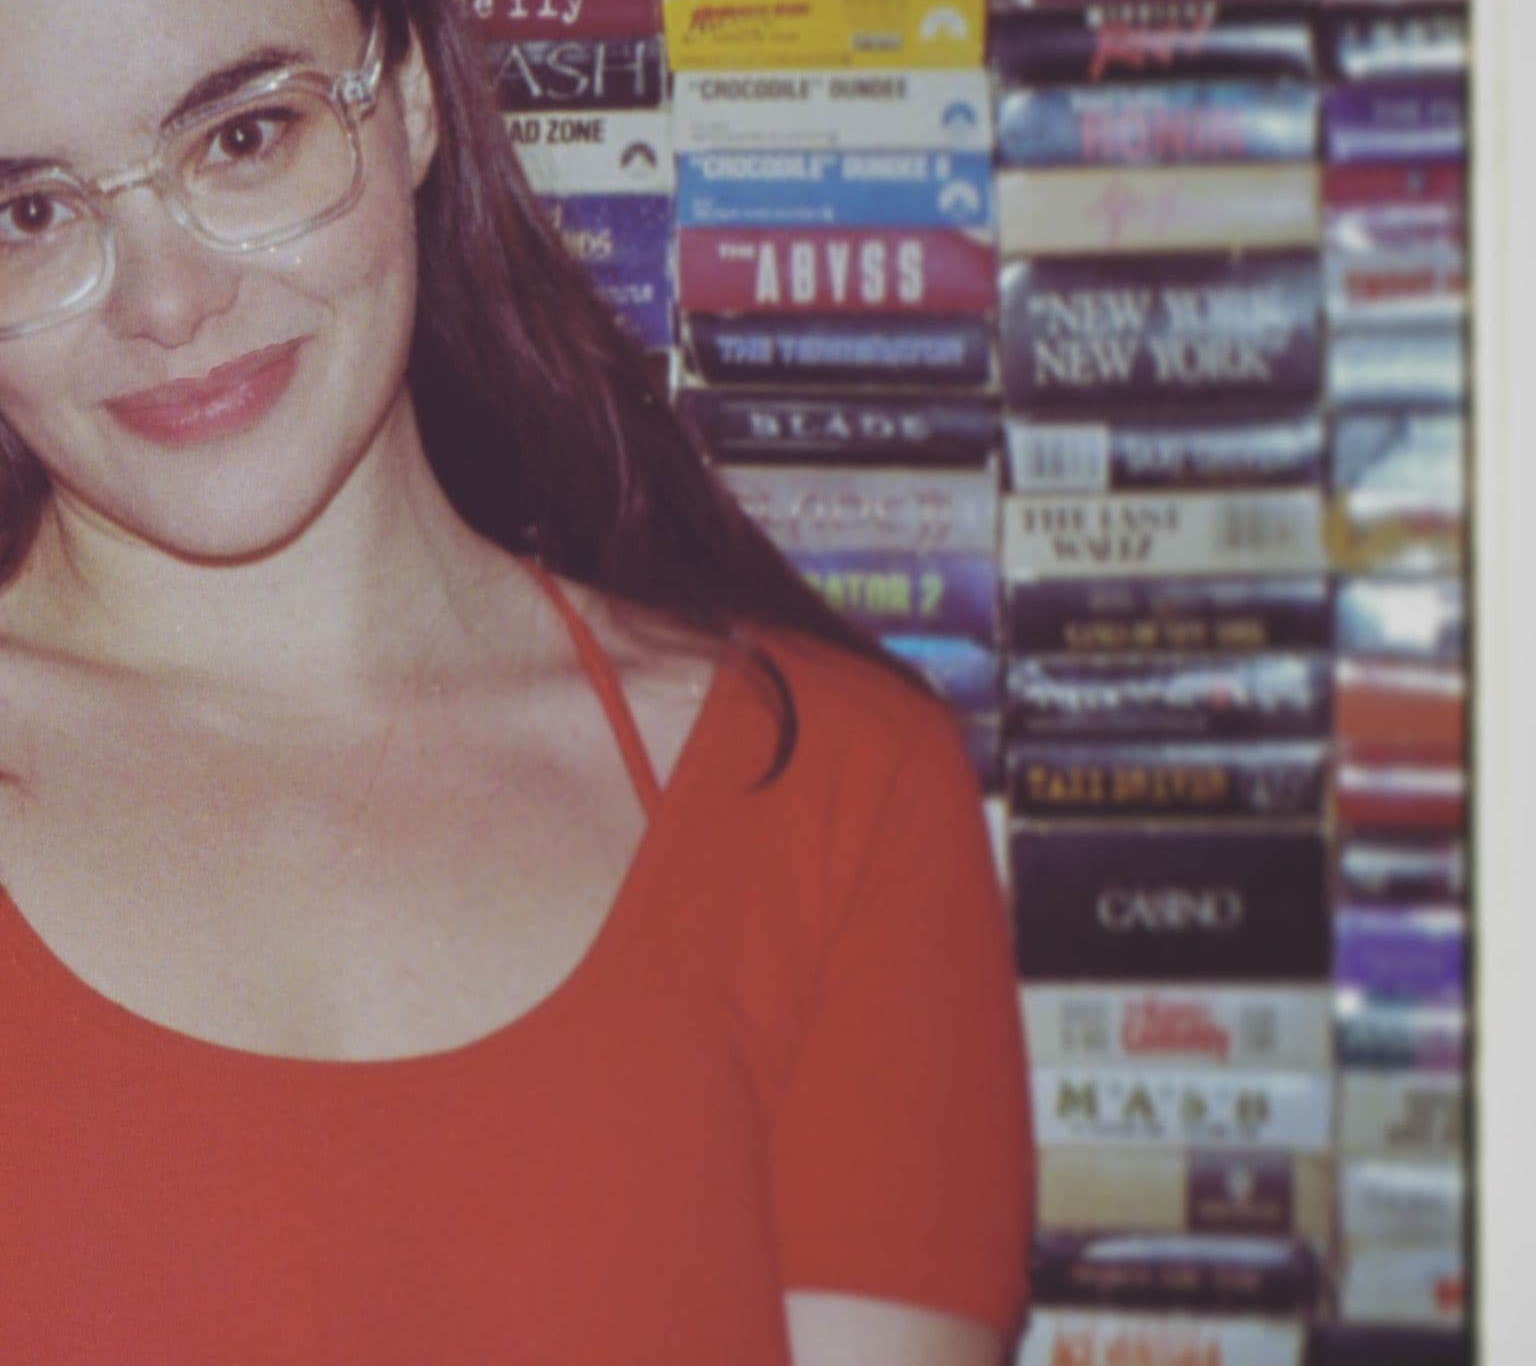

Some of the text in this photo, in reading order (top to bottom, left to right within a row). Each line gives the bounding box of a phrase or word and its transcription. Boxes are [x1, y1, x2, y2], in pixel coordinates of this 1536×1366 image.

[497, 38, 648, 100] ASH
[545, 116, 607, 144] ZONE
[755, 238, 925, 304] ABYSS
[1035, 335, 1272, 388] NEW YORK
